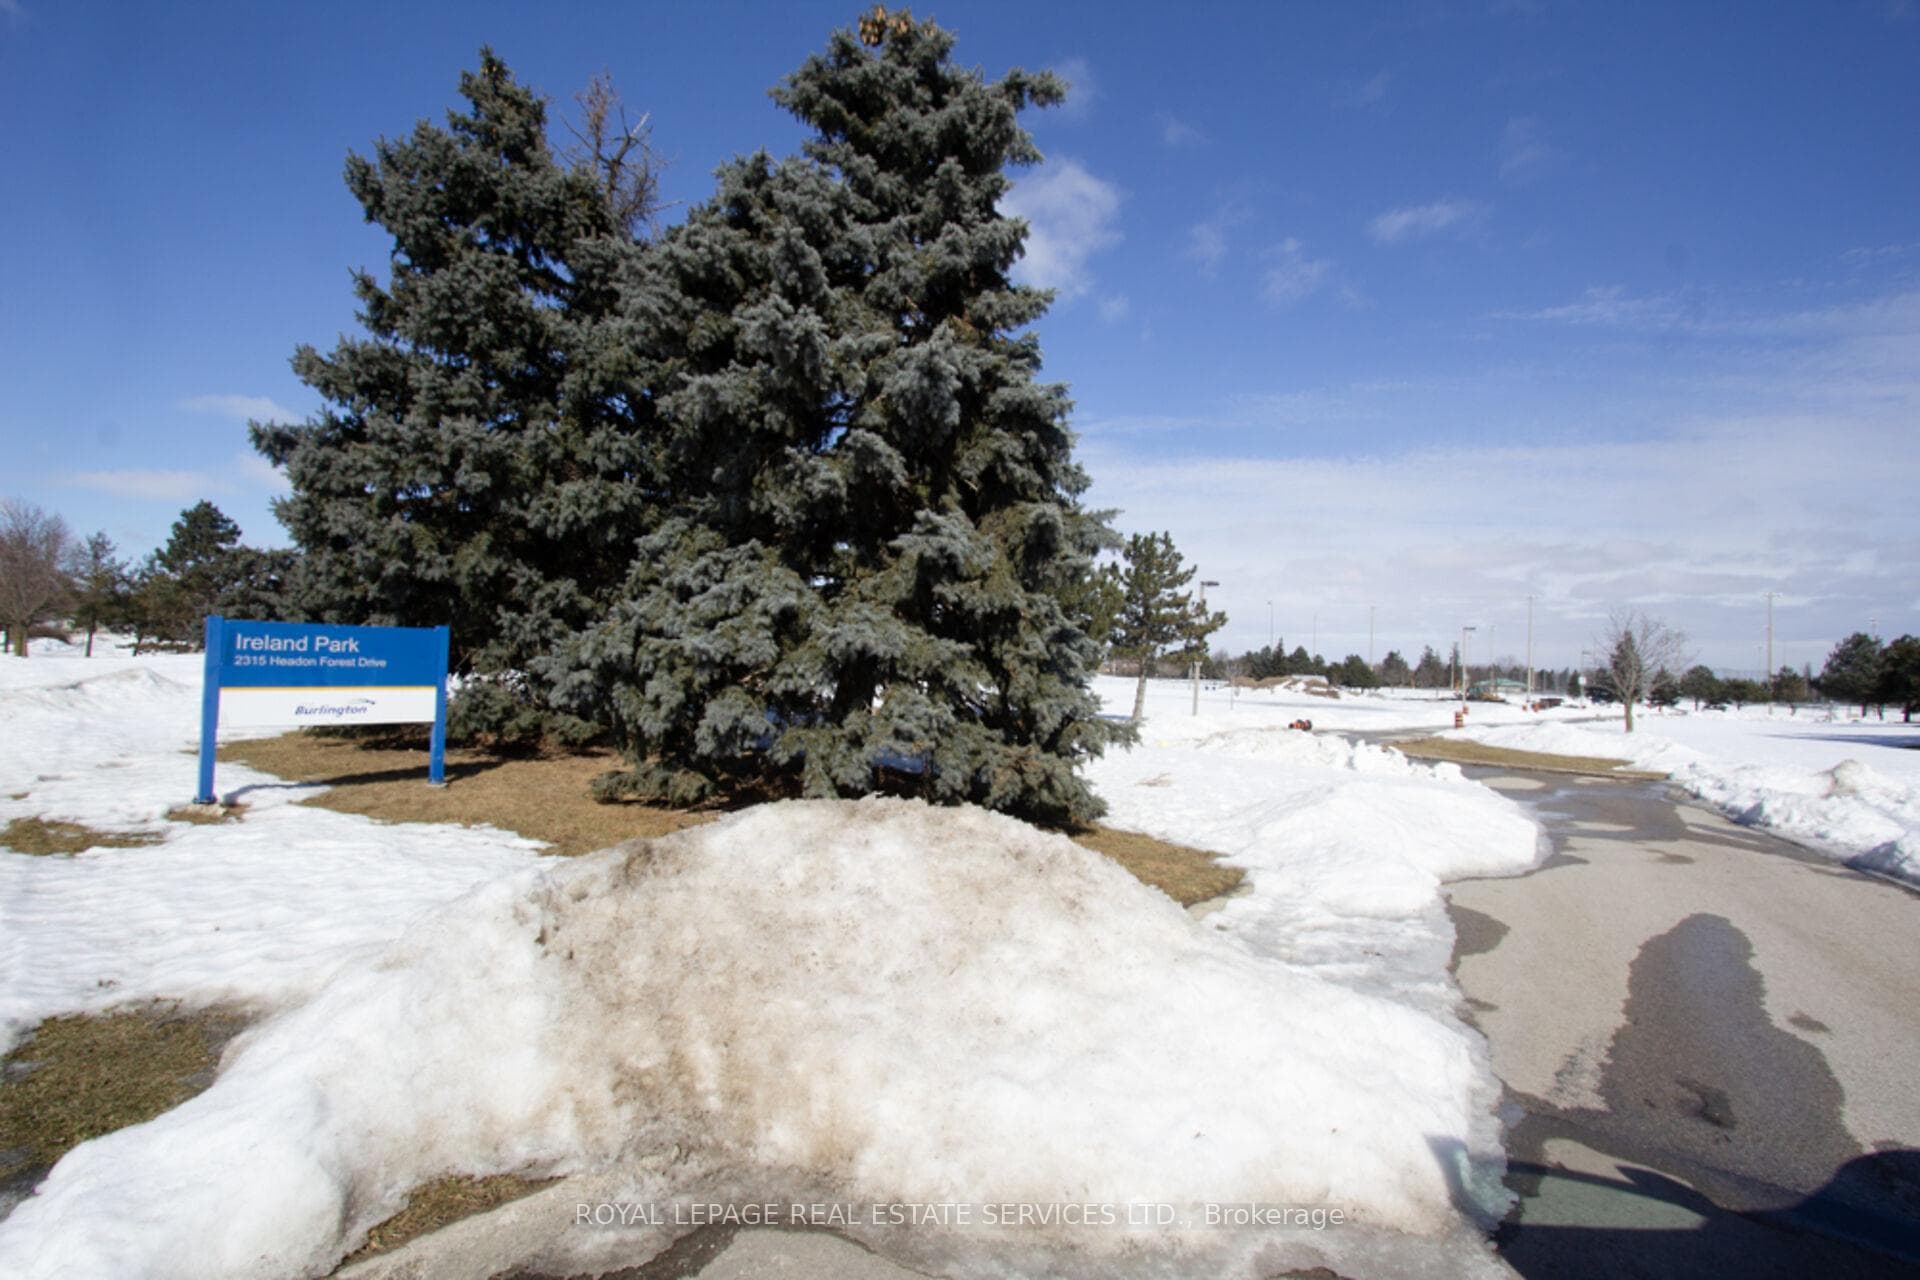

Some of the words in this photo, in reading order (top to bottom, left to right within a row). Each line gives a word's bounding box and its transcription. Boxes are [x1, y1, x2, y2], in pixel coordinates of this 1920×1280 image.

[235, 633, 308, 652] Ireland
[314, 636, 360, 653] Park
[234, 655, 266, 666] 2315
[269, 657, 317, 667] Headon
[320, 657, 356, 668] Forest
[358, 657, 387, 668] Drive
[295, 704, 367, 718] Burlington
